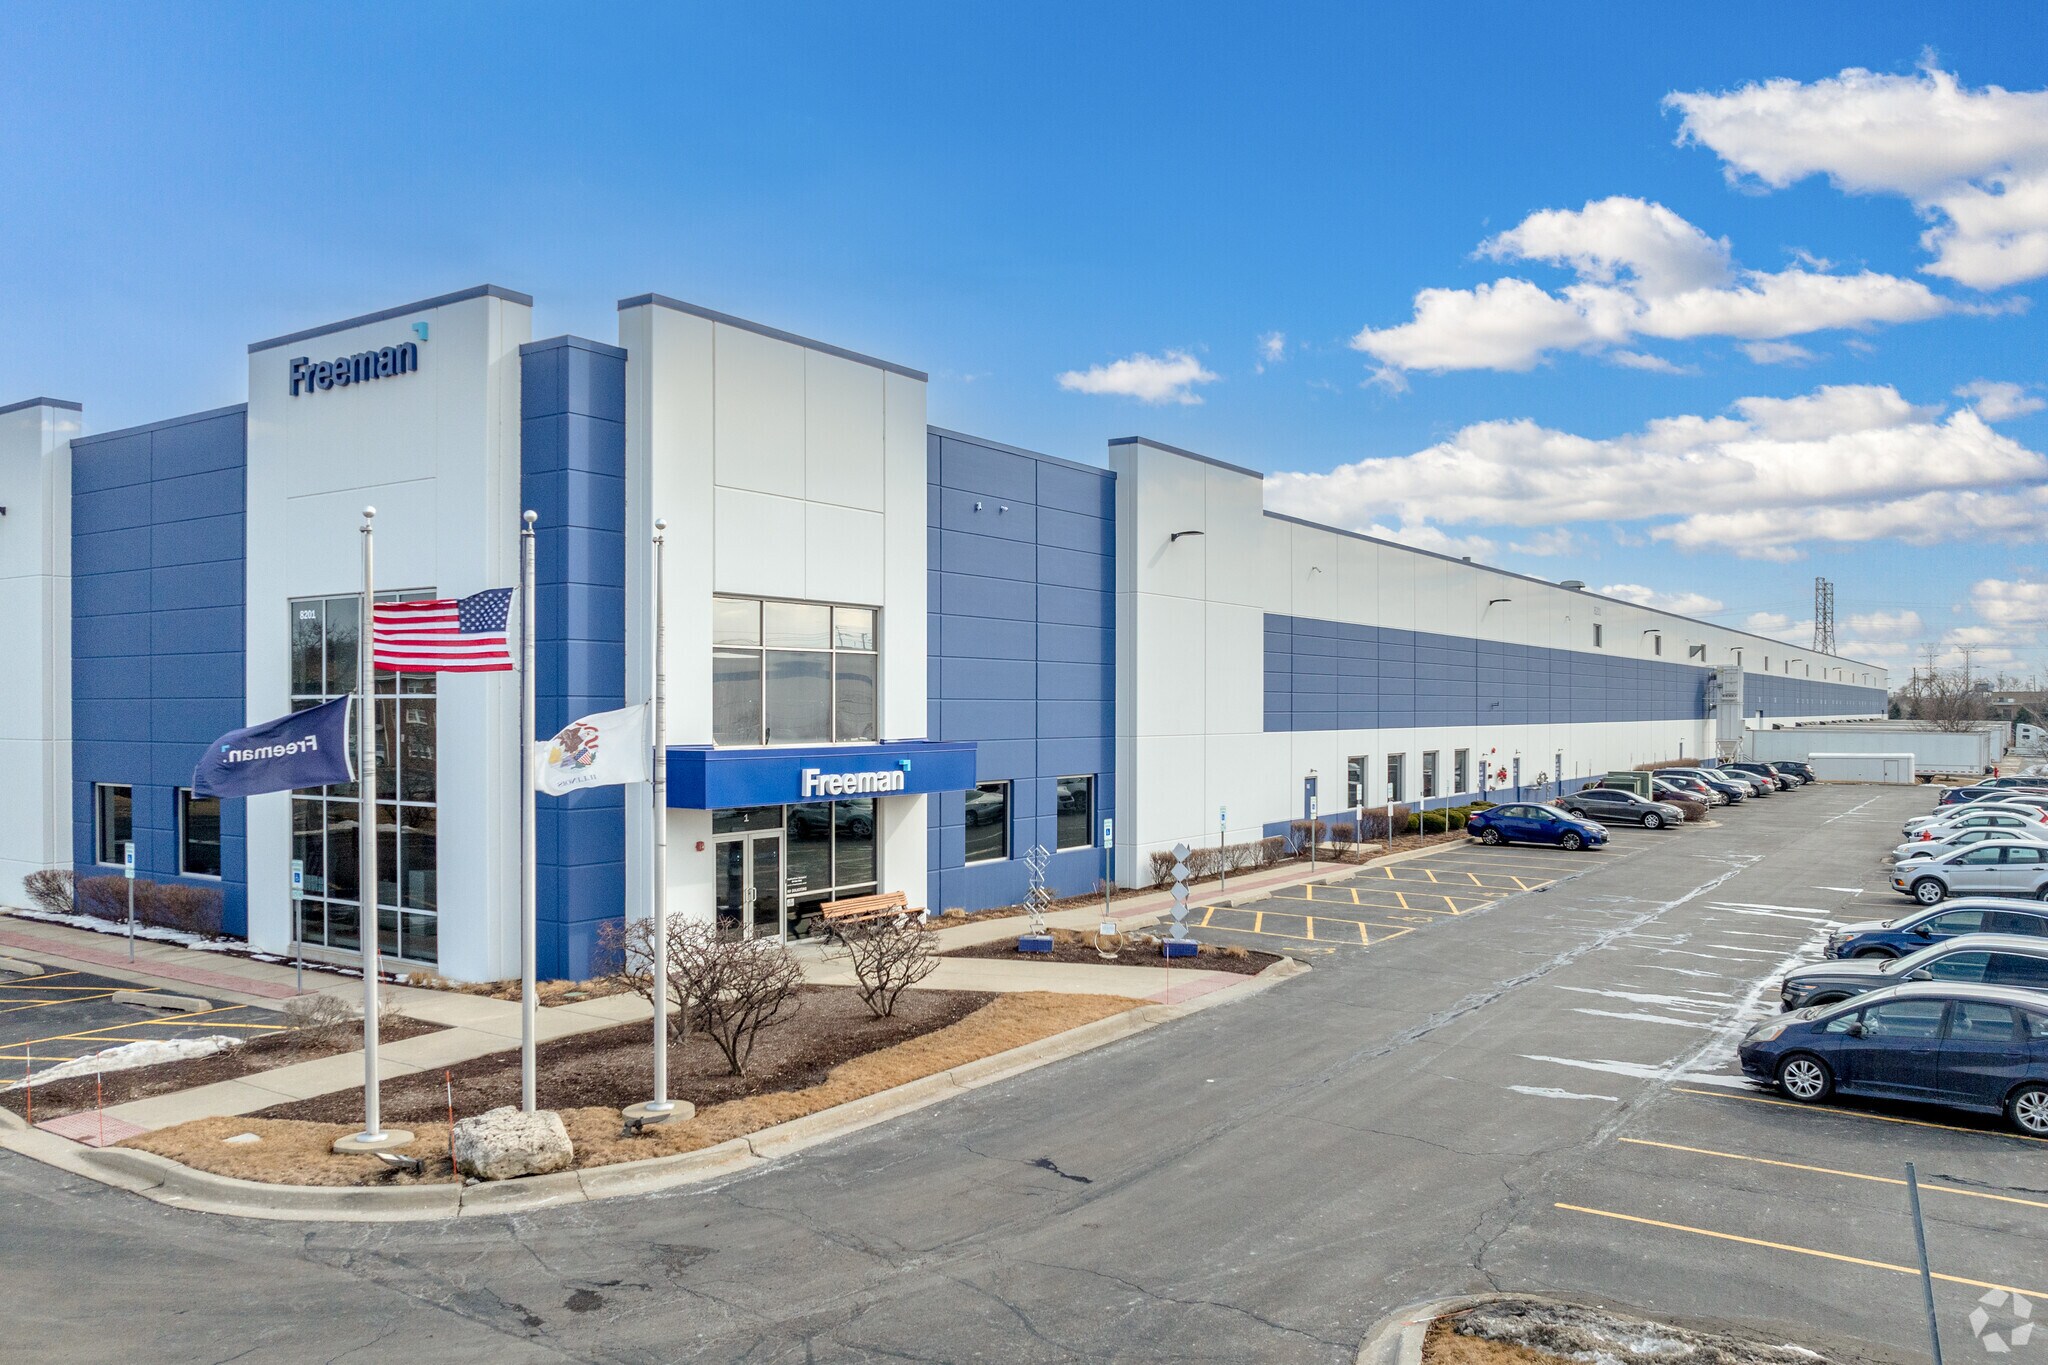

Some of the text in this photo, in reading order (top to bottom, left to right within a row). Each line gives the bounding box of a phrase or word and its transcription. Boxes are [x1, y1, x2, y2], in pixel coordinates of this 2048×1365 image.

[289, 341, 418, 397] Freeman
[300, 610, 316, 619] 8201
[801, 768, 905, 797] Freeman
[743, 813, 750, 822] 1
